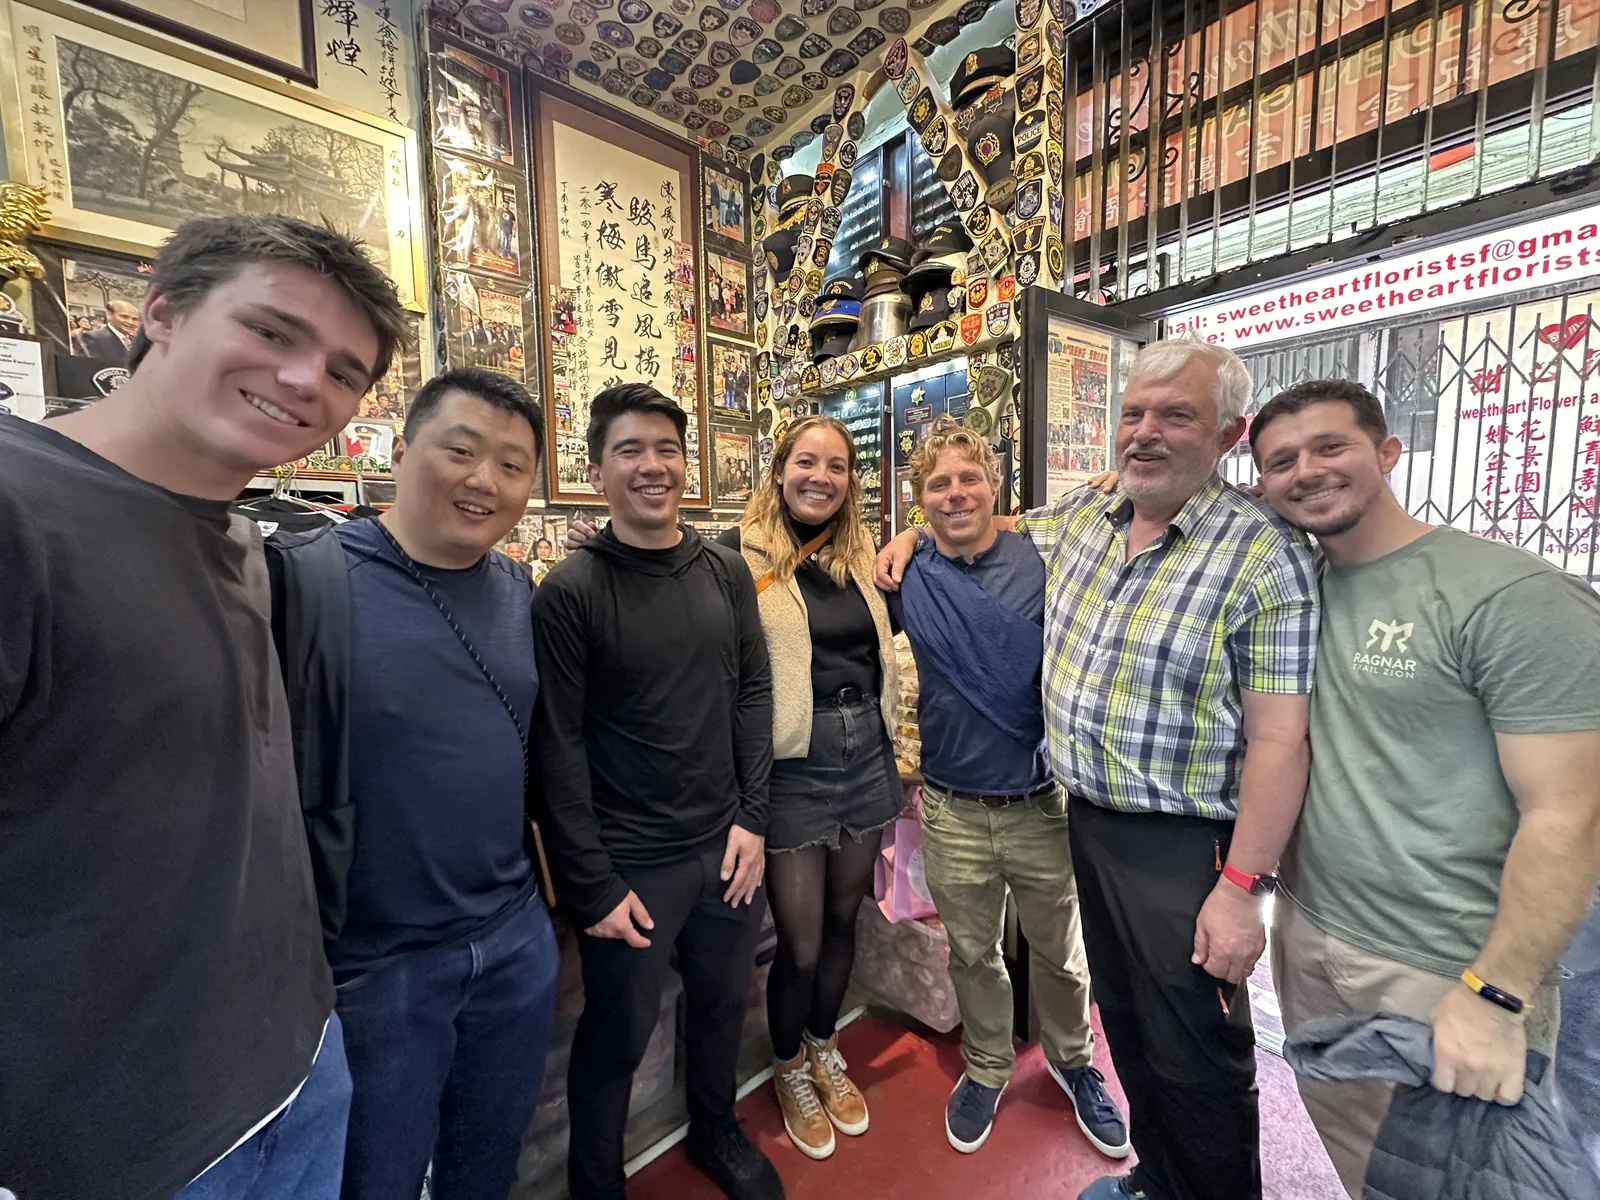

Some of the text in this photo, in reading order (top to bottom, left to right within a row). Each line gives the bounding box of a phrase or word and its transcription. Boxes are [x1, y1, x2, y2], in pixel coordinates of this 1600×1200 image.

[808, 34, 830, 52] POLICE
[1017, 127, 1042, 143] POLICE
[1018, 273, 1037, 284] POLICE
[1217, 223, 1598, 324] sweetheartfloristsf@gma
[626, 196, 662, 389] 駿馬追風揚
[983, 369, 1005, 381] SHERIFF
[1353, 652, 1417, 672] RAGNAR
[1382, 668, 1414, 679] ZION
